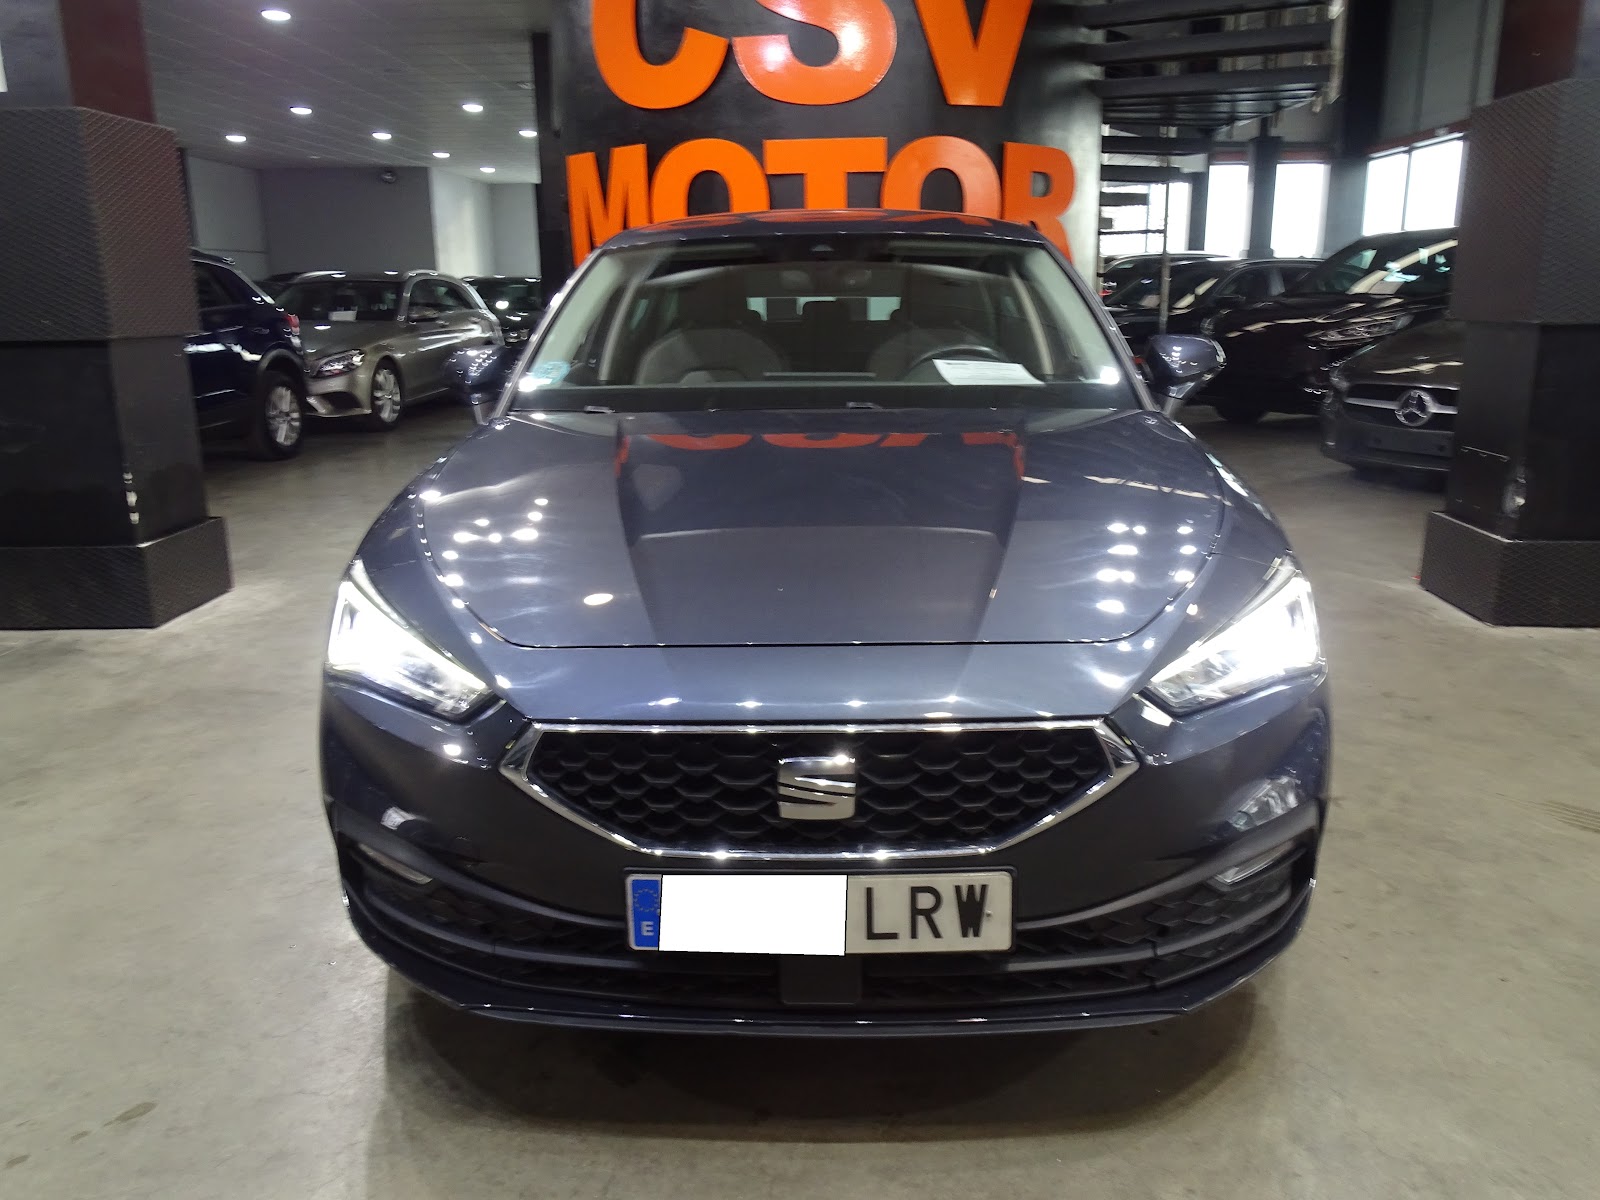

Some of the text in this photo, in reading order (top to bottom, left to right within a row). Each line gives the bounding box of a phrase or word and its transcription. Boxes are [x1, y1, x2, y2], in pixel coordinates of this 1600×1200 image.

[566, 135, 1075, 268] MOTOR
[641, 884, 989, 940] E LRW
